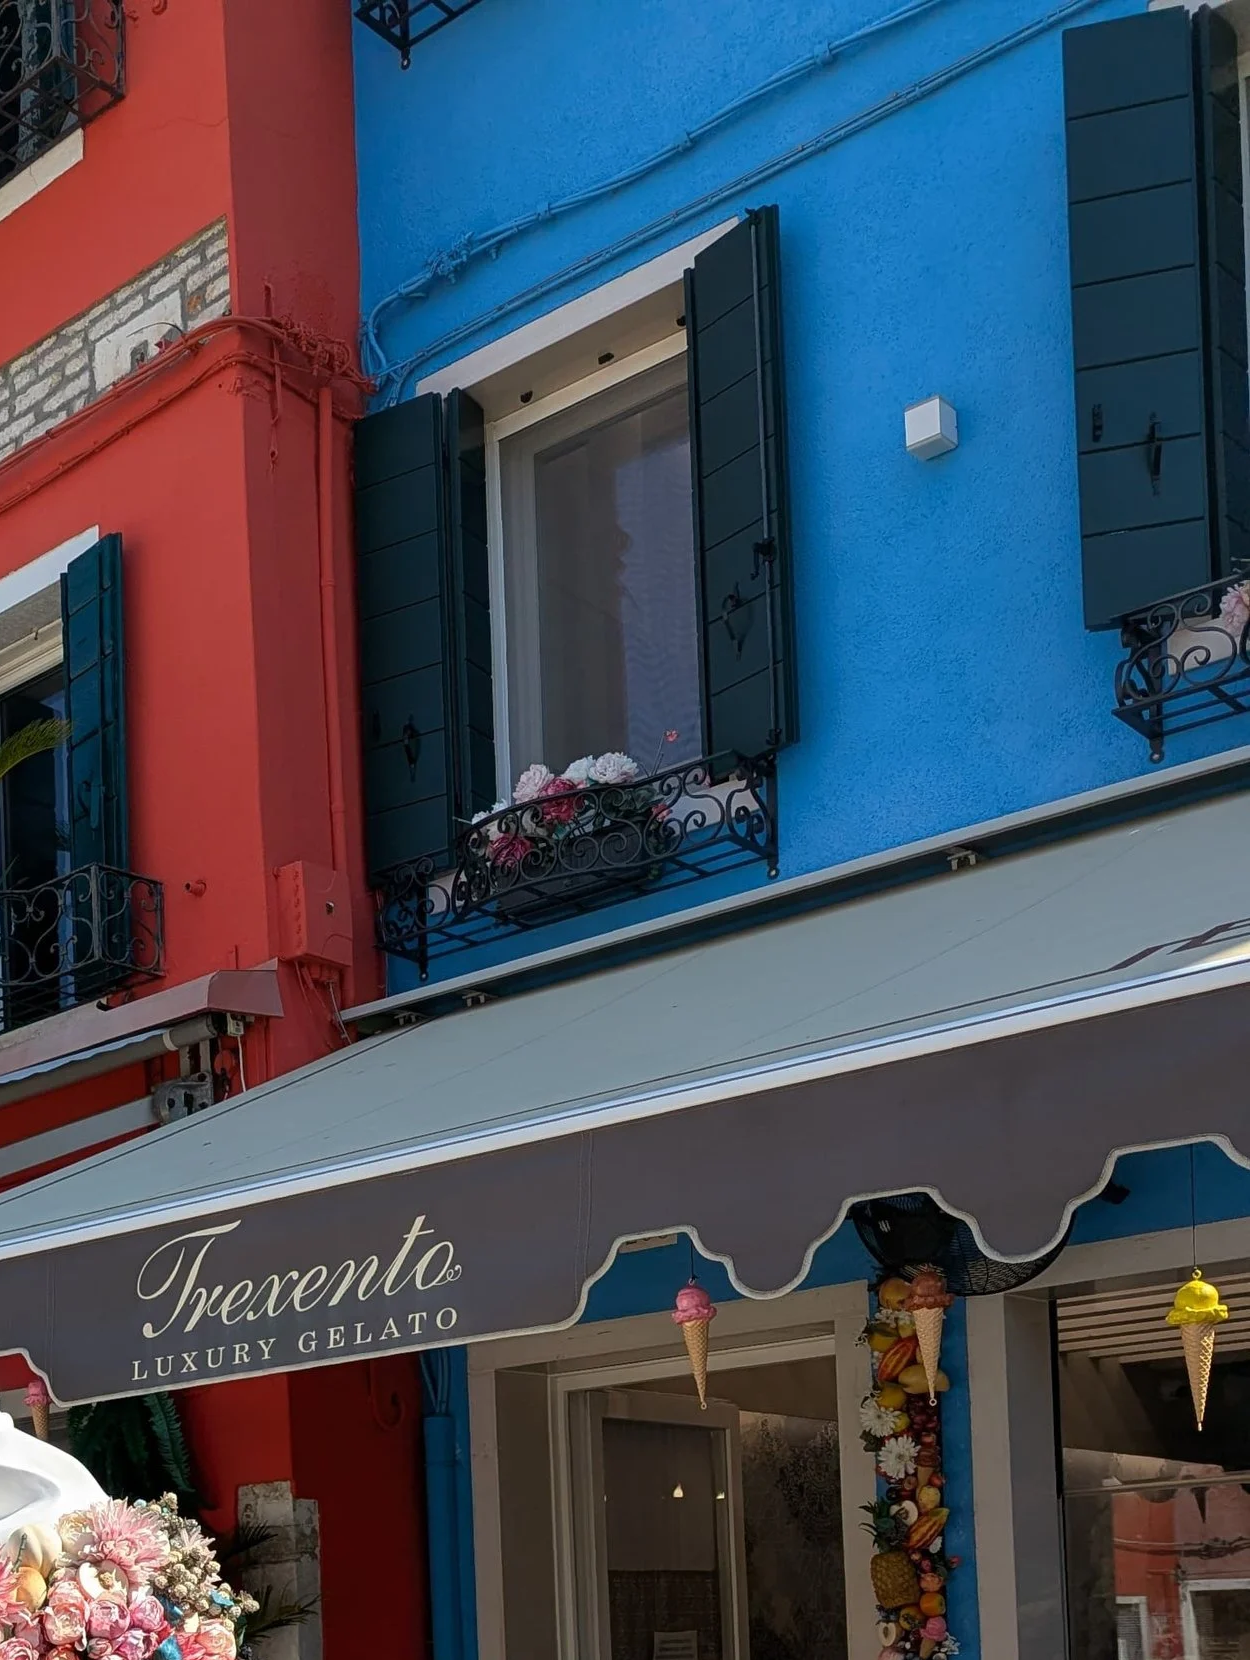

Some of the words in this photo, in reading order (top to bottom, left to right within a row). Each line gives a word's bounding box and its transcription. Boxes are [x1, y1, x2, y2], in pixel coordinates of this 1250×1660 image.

[136, 1214, 462, 1339] Trexento
[131, 1337, 277, 1381] LUXURY
[298, 1307, 458, 1354] GELATO
